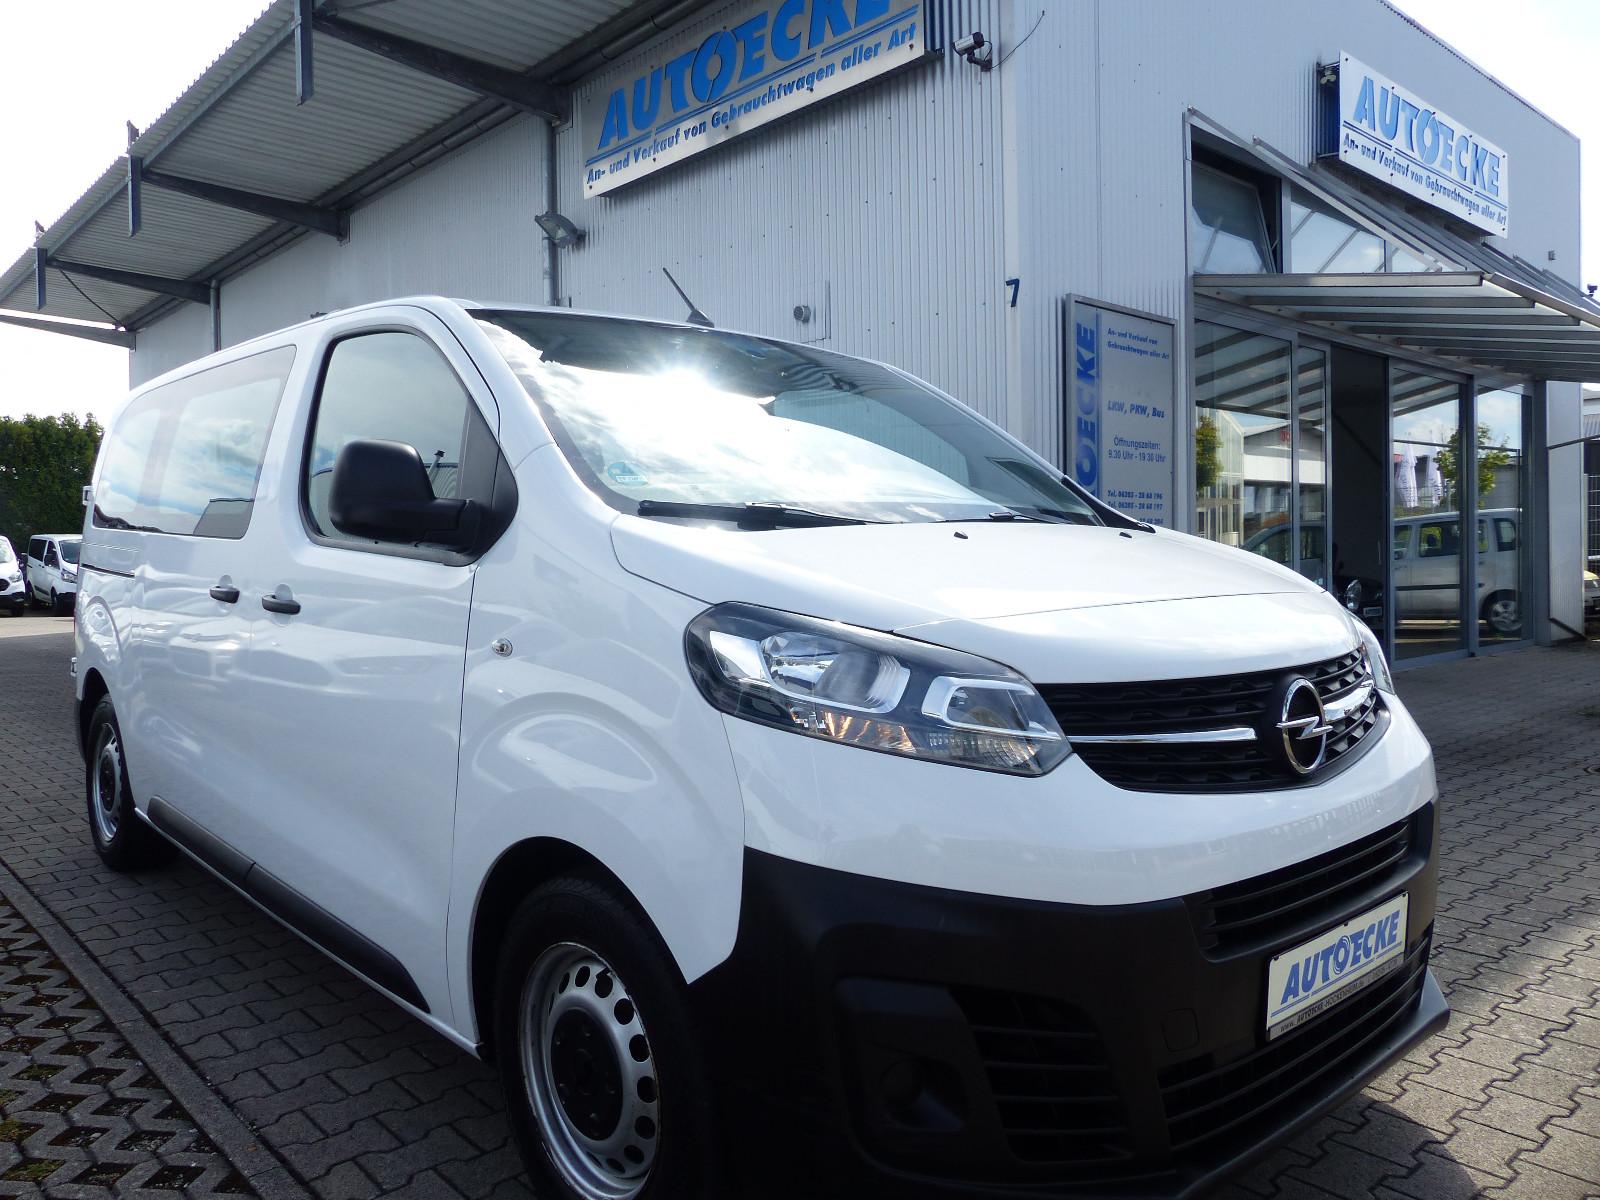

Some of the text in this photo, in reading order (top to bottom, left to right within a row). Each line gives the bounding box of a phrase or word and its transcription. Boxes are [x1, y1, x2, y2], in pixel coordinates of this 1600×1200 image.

[586, 23, 917, 185] An- und Verkauf von Gebrauchtwagen aller Art
[1353, 76, 1500, 197] AUTOECKE
[1343, 132, 1359, 150] An-
[1361, 145, 1377, 161] und
[1378, 151, 1410, 176] Verkauf
[1410, 170, 1424, 185] von
[1425, 175, 1480, 216] Gebrauchtwagen
[1481, 204, 1496, 219] aller
[1005, 278, 1020, 308] 7
[1076, 322, 1097, 496] OECKE
[1129, 403, 1150, 418] PKW,
[1151, 407, 1165, 419] Bus
[1122, 451, 1134, 460] Uhr
[1280, 909, 1401, 1006] AUTOECKE
